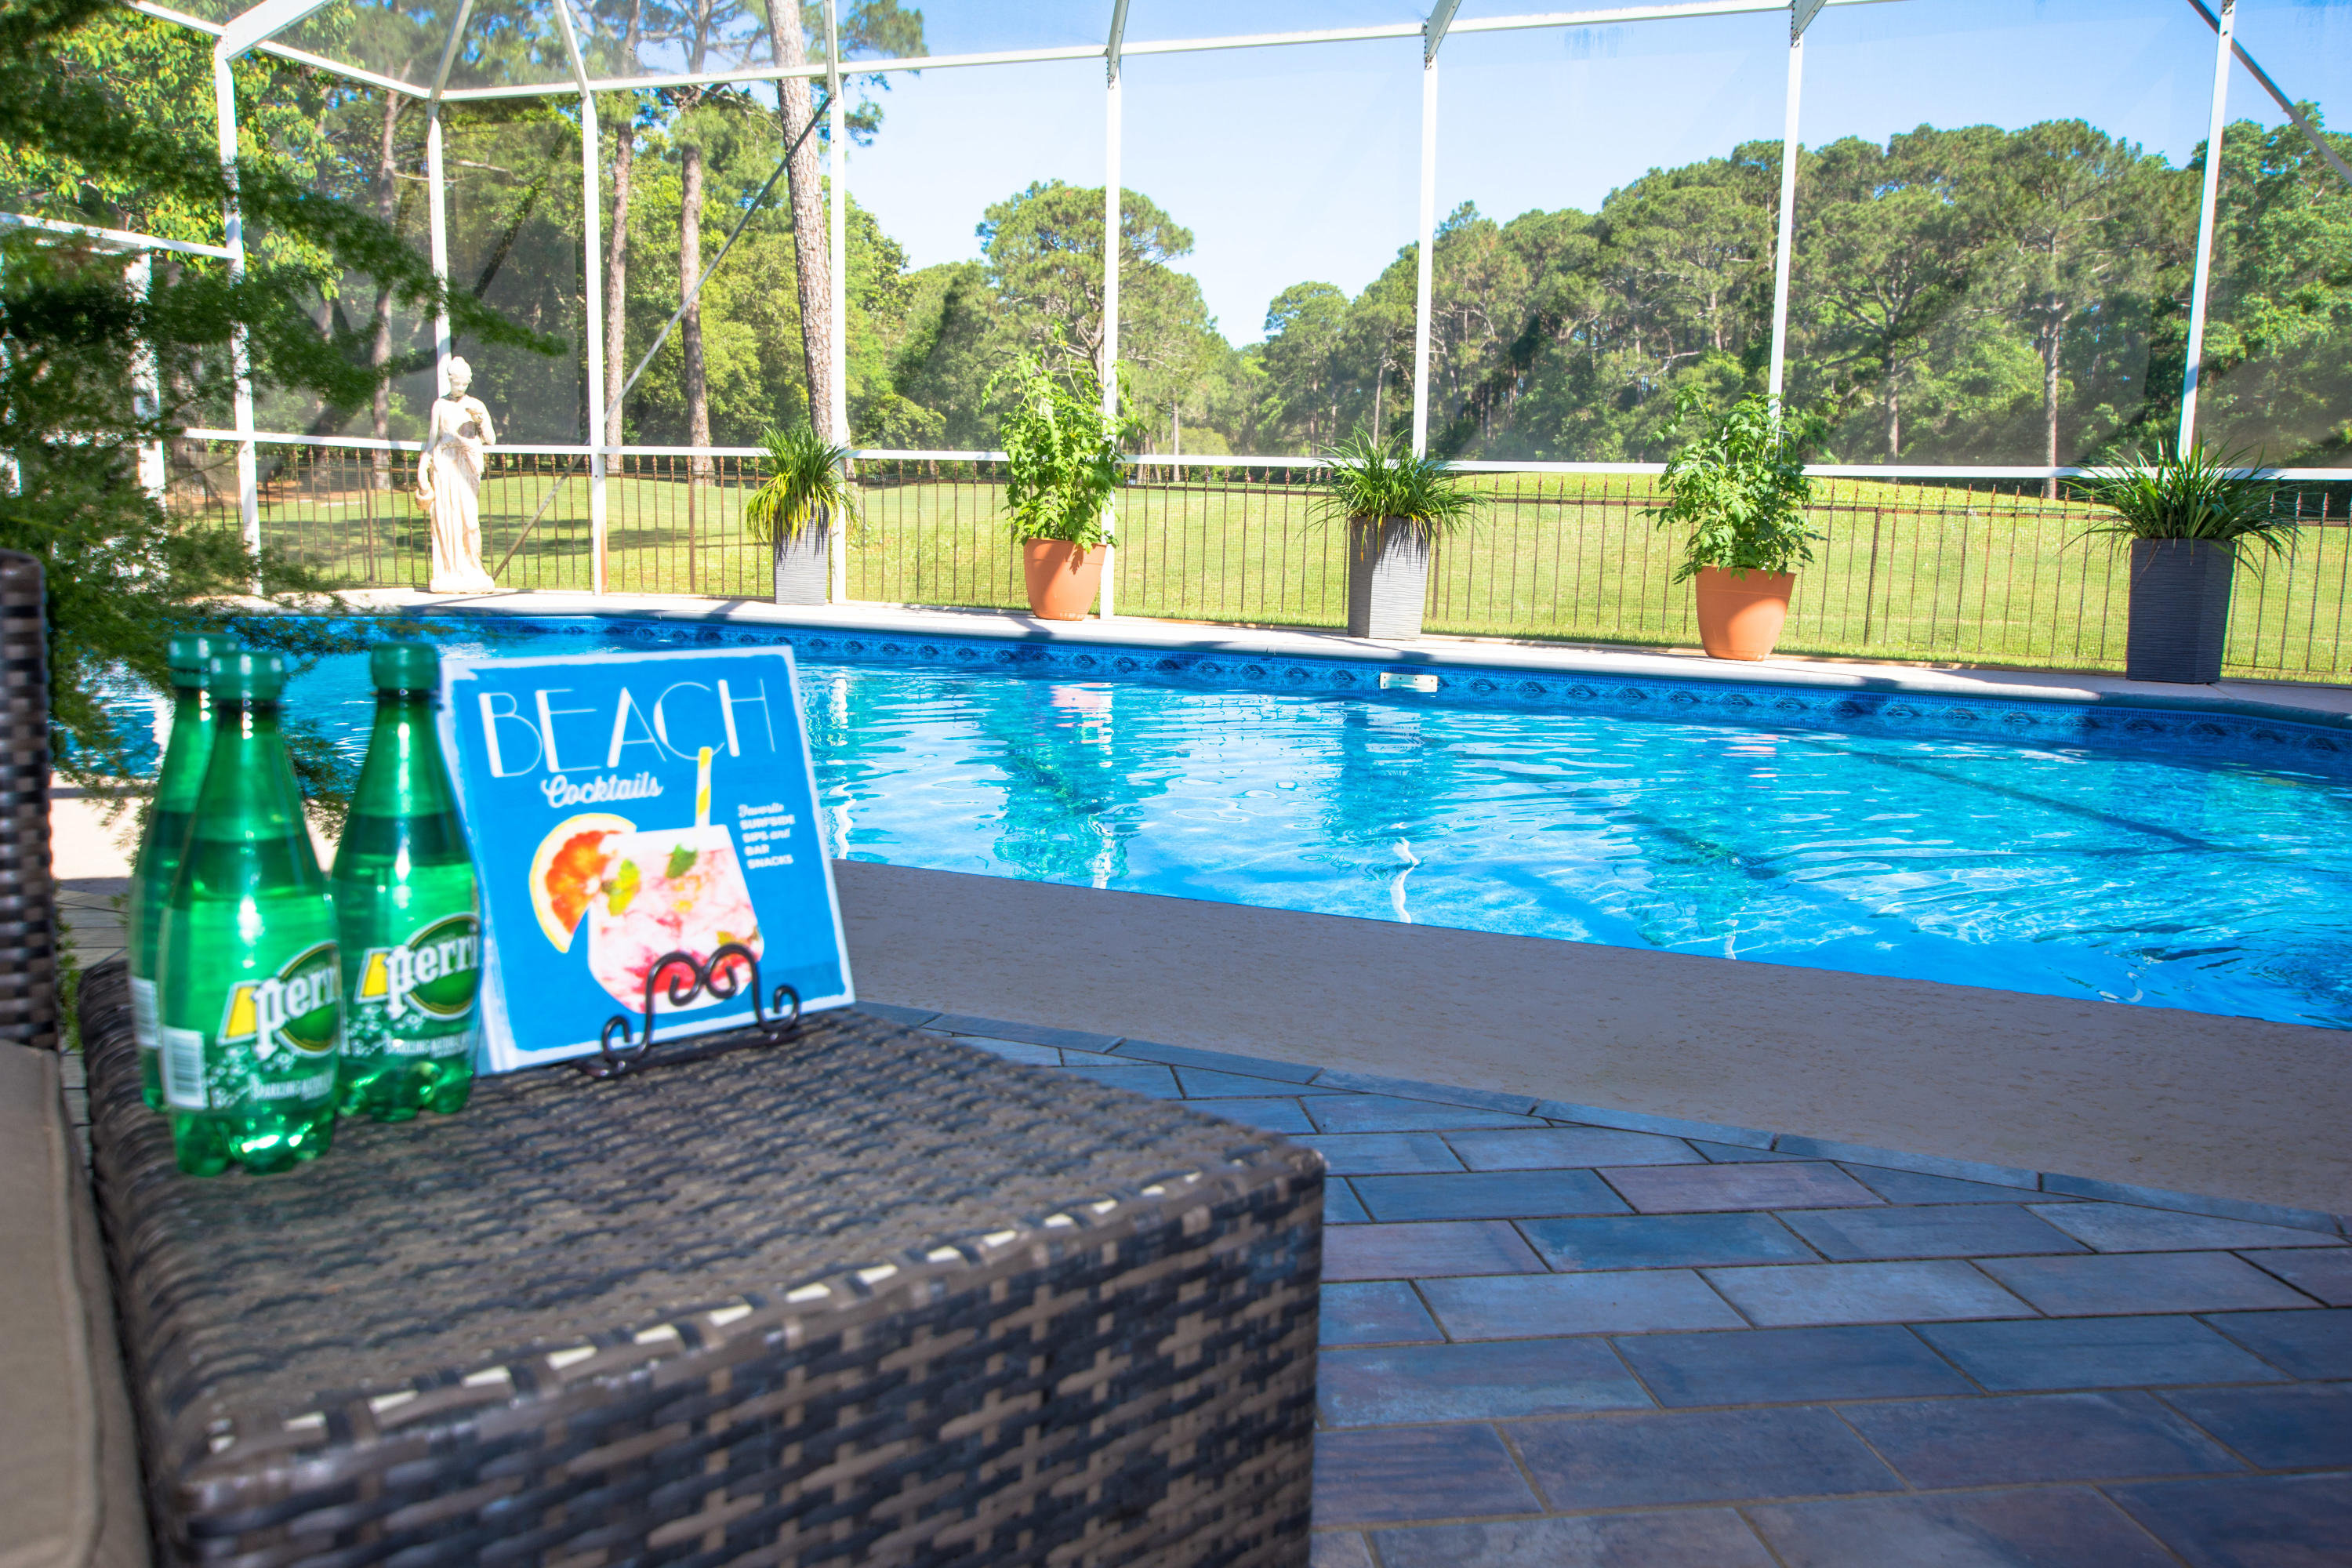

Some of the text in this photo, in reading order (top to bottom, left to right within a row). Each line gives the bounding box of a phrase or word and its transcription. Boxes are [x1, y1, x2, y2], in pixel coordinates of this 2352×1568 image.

[478, 678, 775, 778] BEACH
[540, 771, 664, 808] Cocktails
[746, 854, 794, 869] SNACKS
